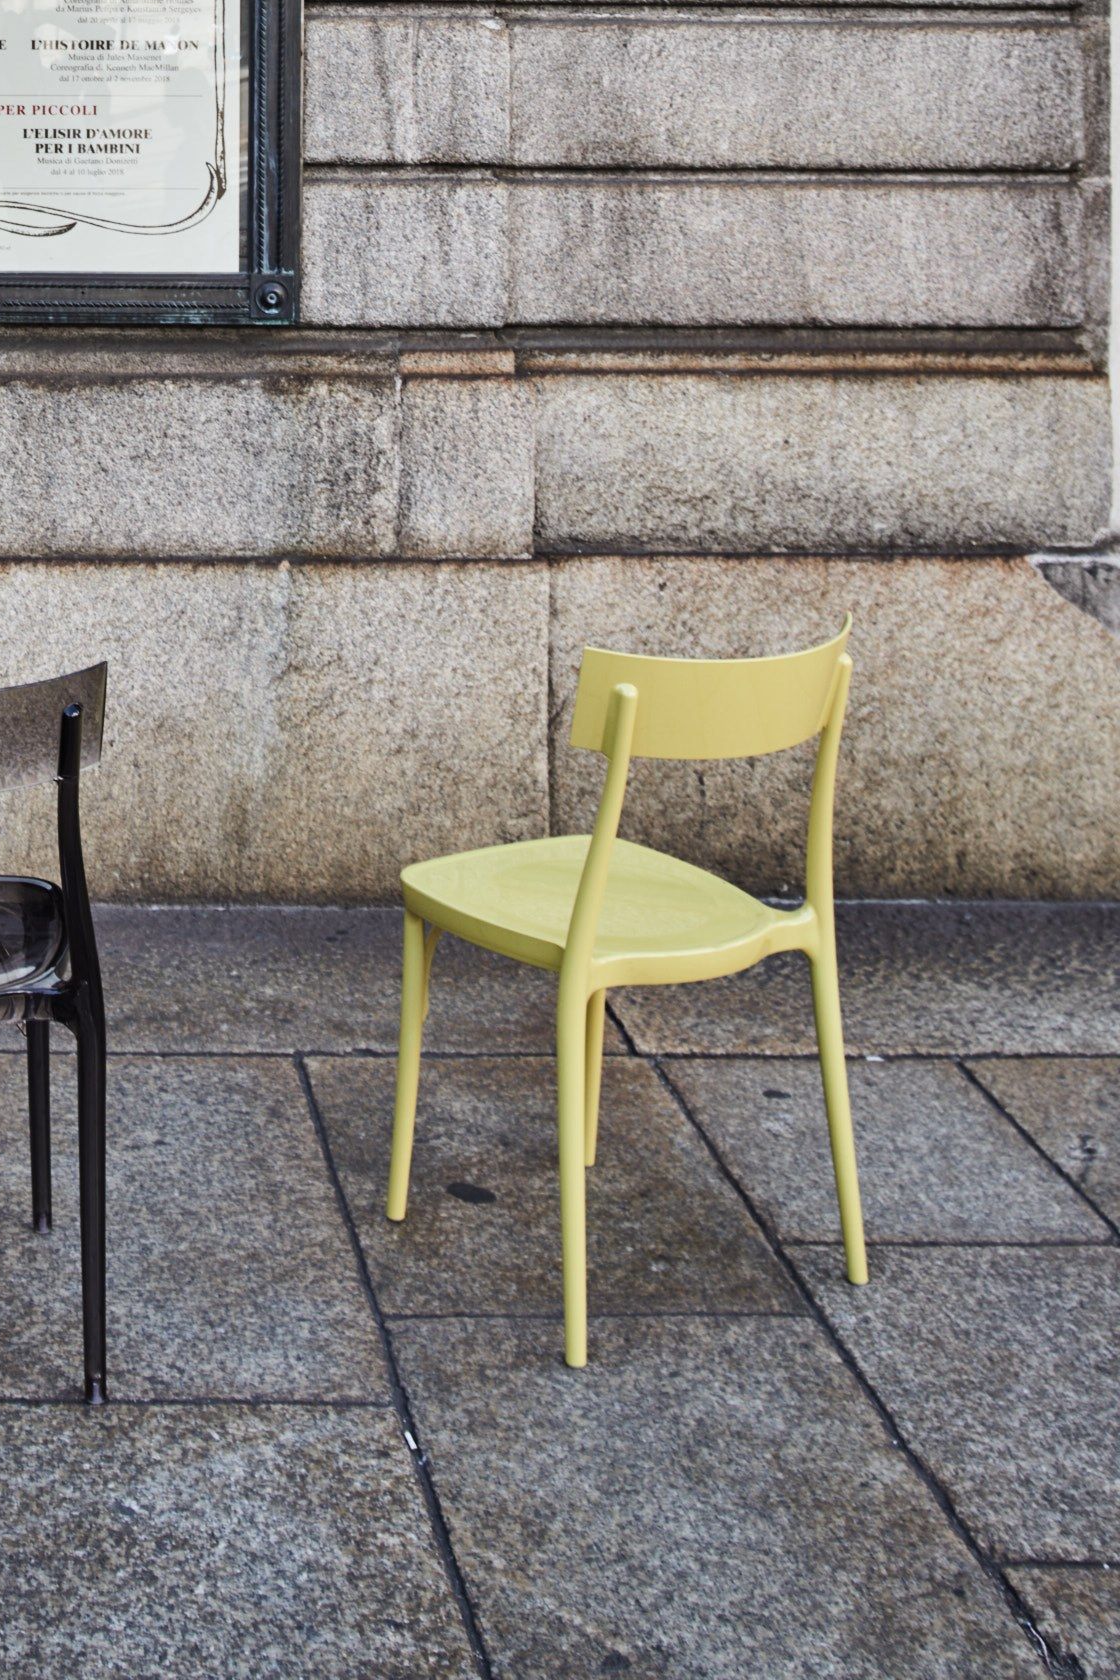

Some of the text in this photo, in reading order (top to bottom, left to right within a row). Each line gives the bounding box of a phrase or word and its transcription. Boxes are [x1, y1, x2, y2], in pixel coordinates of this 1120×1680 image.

[31, 39, 199, 51] L'HISTOIRE DE MAON
[50, 64, 93, 73] Coreografia
[32, 104, 98, 115] PICCOLI
[23, 128, 153, 139] L'ELISIR D'AMORE
[35, 143, 140, 154] PER I BAMBINI
[87, 168, 107, 177] luglio
[109, 168, 125, 176] 2018
